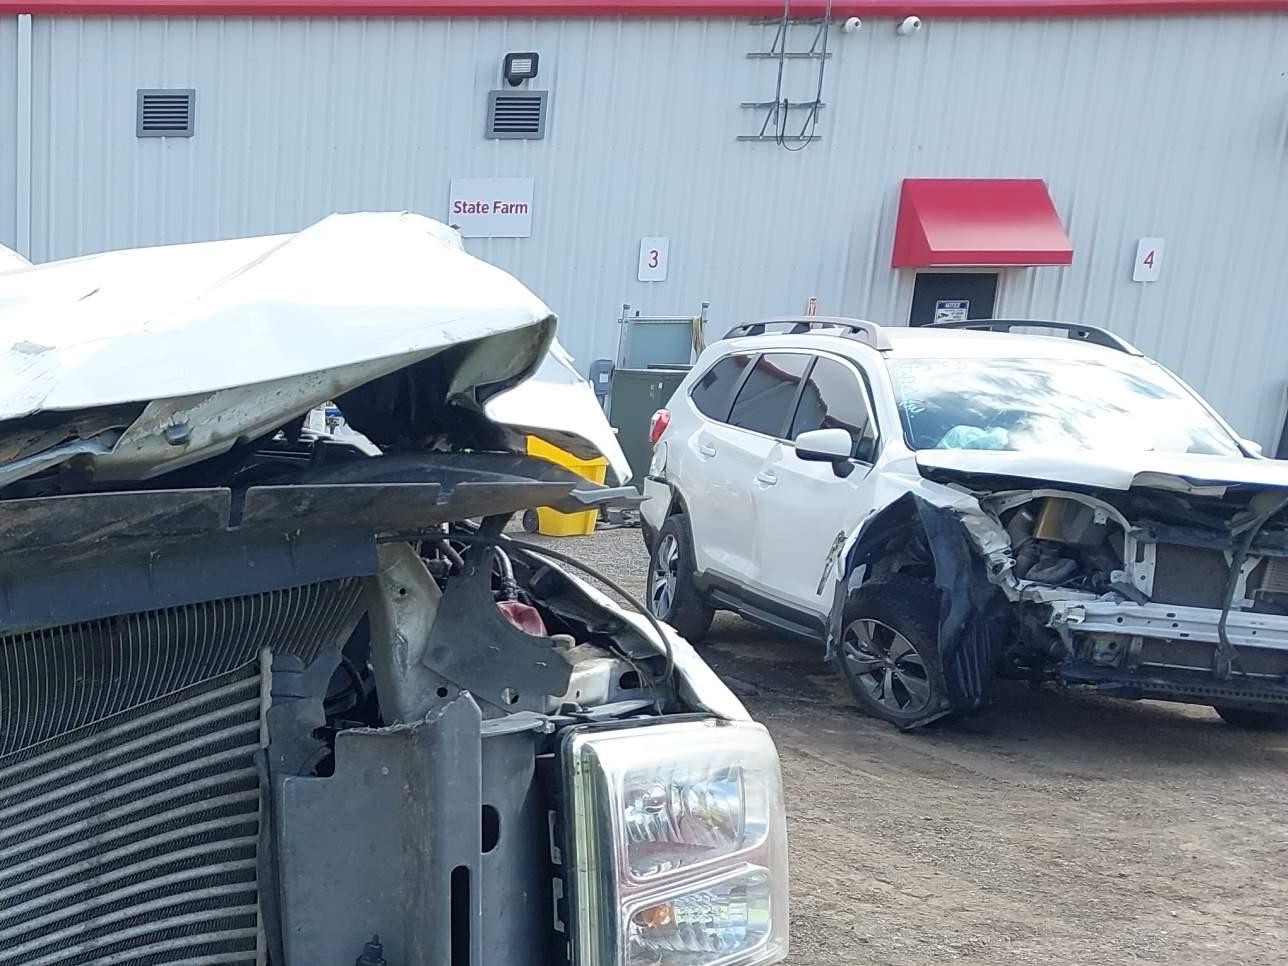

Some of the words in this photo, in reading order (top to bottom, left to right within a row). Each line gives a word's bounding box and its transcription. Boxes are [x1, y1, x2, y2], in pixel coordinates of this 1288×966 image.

[453, 200, 489, 214] State
[492, 200, 528, 214] Farm
[648, 249, 659, 269] 3
[1143, 250, 1155, 269] 4
